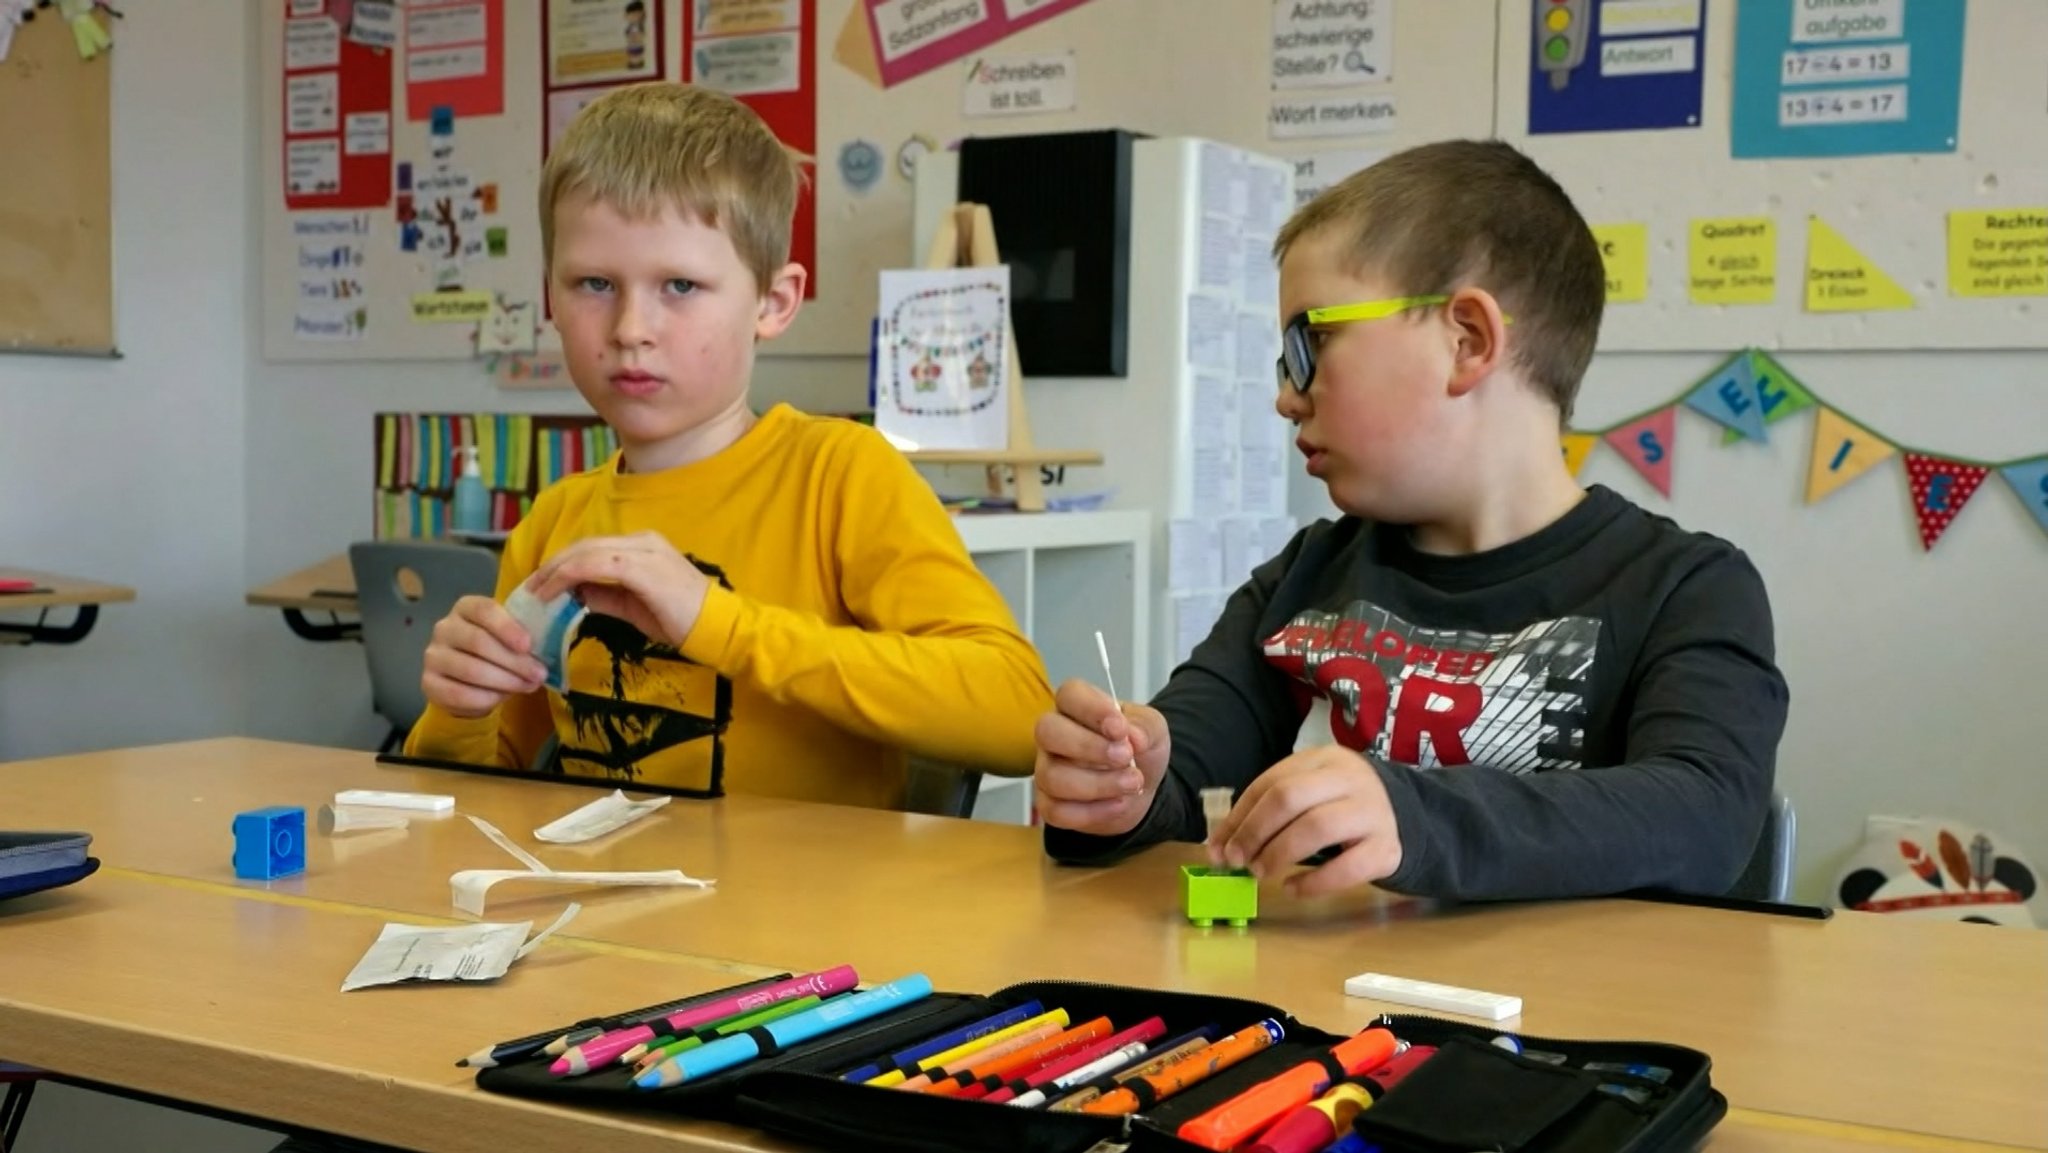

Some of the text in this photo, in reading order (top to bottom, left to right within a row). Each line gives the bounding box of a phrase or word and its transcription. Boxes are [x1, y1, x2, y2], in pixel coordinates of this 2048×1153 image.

[888, 3, 979, 50] Satzanfang
[1805, 14, 1887, 38] aufgabe
[1274, 26, 1374, 50] schwierige
[1273, 54, 1339, 77] Stelle?
[1604, 46, 1673, 65] Antwort
[1786, 56, 1808, 75] 17
[1869, 51, 1891, 71] 13
[980, 61, 1065, 84] Schreiben
[990, 91, 1009, 109] ist
[1786, 98, 1808, 117] 13
[1870, 93, 1894, 113] 17
[1271, 104, 1315, 124] Wort
[1701, 224, 1766, 240] Quadrat
[1986, 214, 2048, 229] Rechte
[1810, 266, 1865, 281] Dreieck
